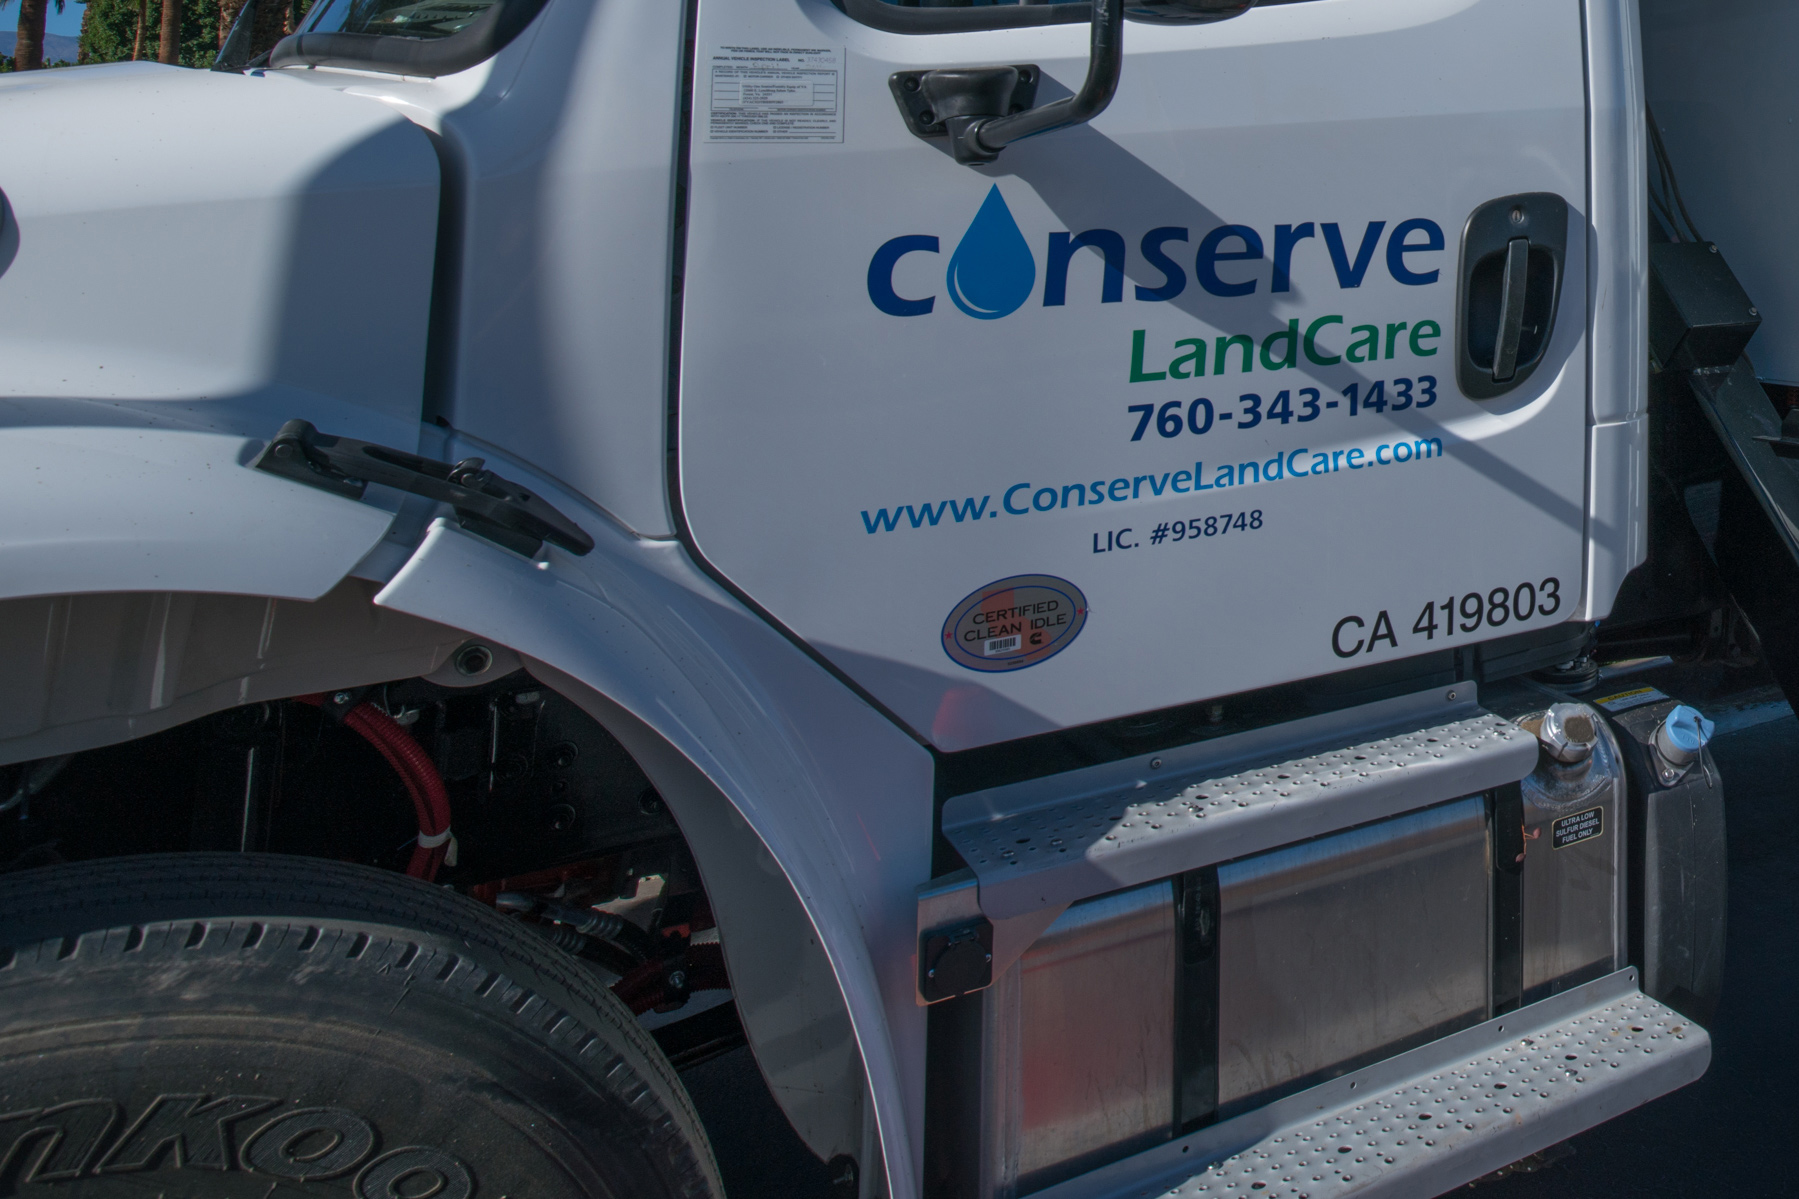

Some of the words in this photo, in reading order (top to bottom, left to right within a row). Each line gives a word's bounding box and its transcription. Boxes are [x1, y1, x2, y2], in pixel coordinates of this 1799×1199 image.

[867, 183, 1446, 321] conserve
[1127, 314, 1442, 384] LandCare
[1127, 374, 1439, 442] 760-343-1433
[860, 436, 1444, 535] www.ConserveLandCare.com
[1092, 527, 1140, 554] LIC.
[1149, 509, 1264, 546] #958748
[963, 622, 1022, 642] CLEAN
[1030, 613, 1067, 630] IDLE
[973, 600, 1058, 625] CERTIFIED
[1331, 610, 1398, 659] CA
[1411, 577, 1562, 643] 419803
[1556, 824, 1579, 837] SULFUR
[1579, 818, 1600, 830] DIESEL
[1561, 815, 1580, 827] ULTRA
[1581, 810, 1595, 820] LOW
[1562, 834, 1578, 844] FUEL
[1578, 828, 1593, 838] ONLY
